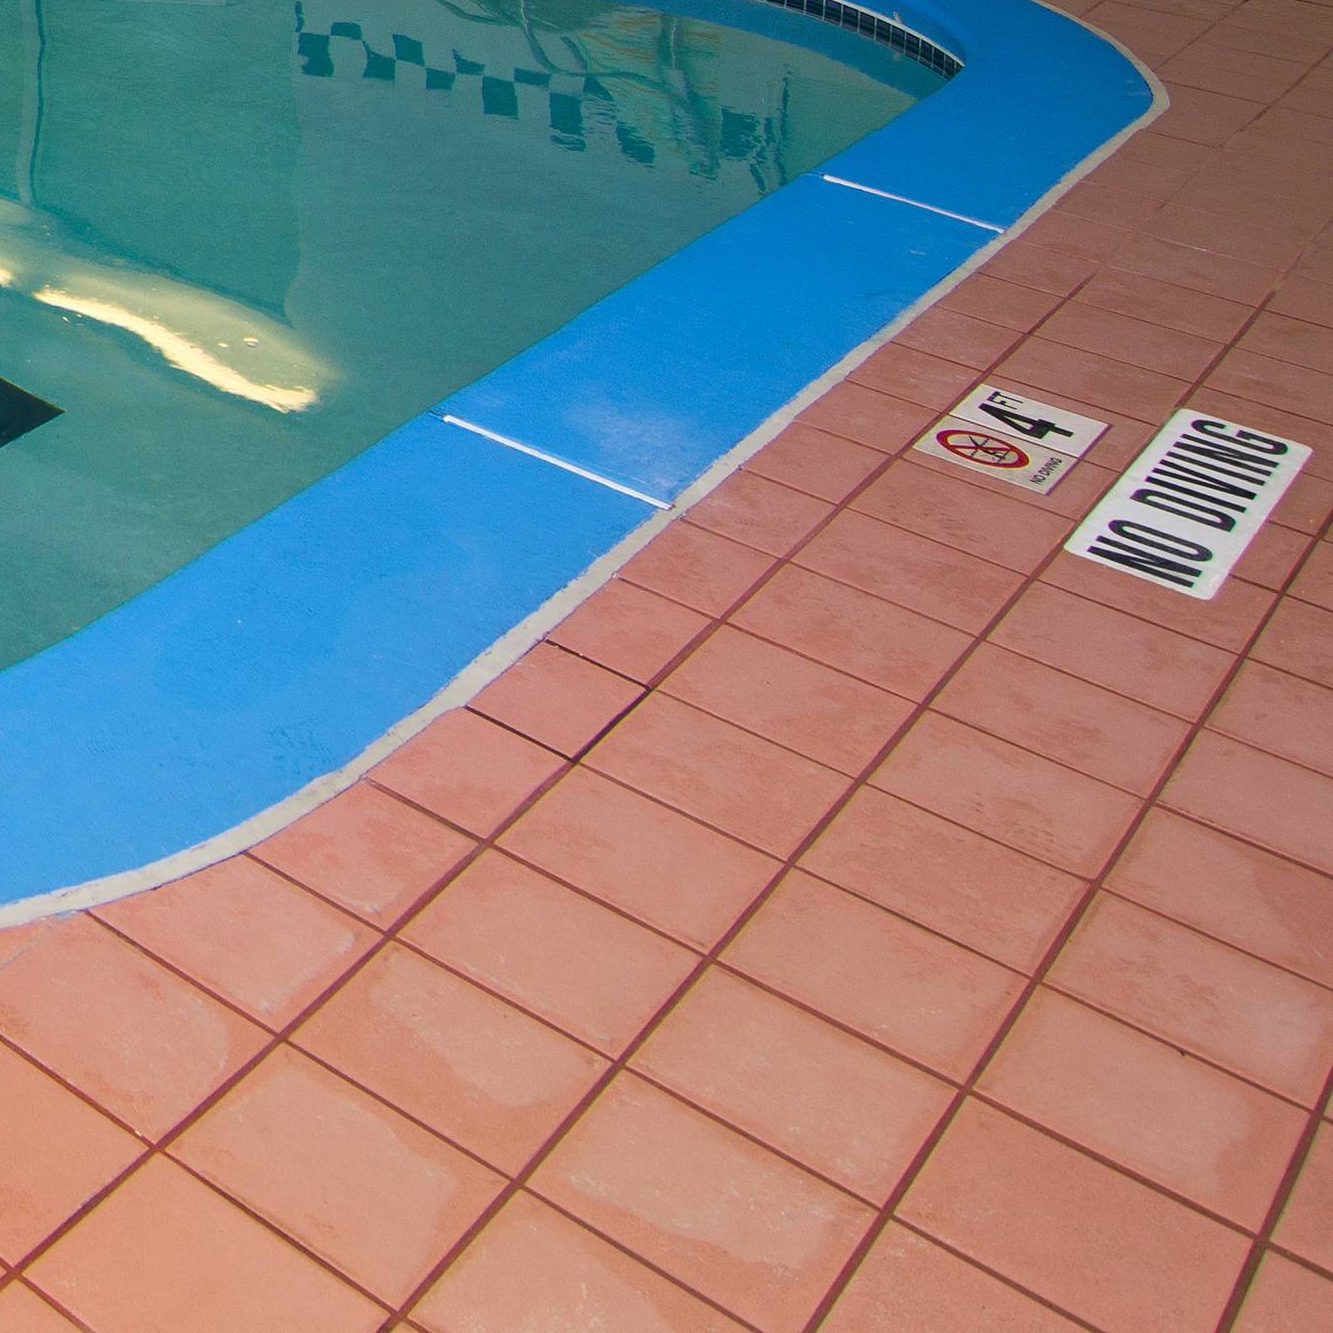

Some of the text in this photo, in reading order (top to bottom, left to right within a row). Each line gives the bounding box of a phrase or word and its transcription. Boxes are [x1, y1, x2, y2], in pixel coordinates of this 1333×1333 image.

[978, 391, 1074, 440] 4 FT
[1029, 457, 1063, 486] NO DIVING
[1087, 419, 1289, 588] NO DIVING
